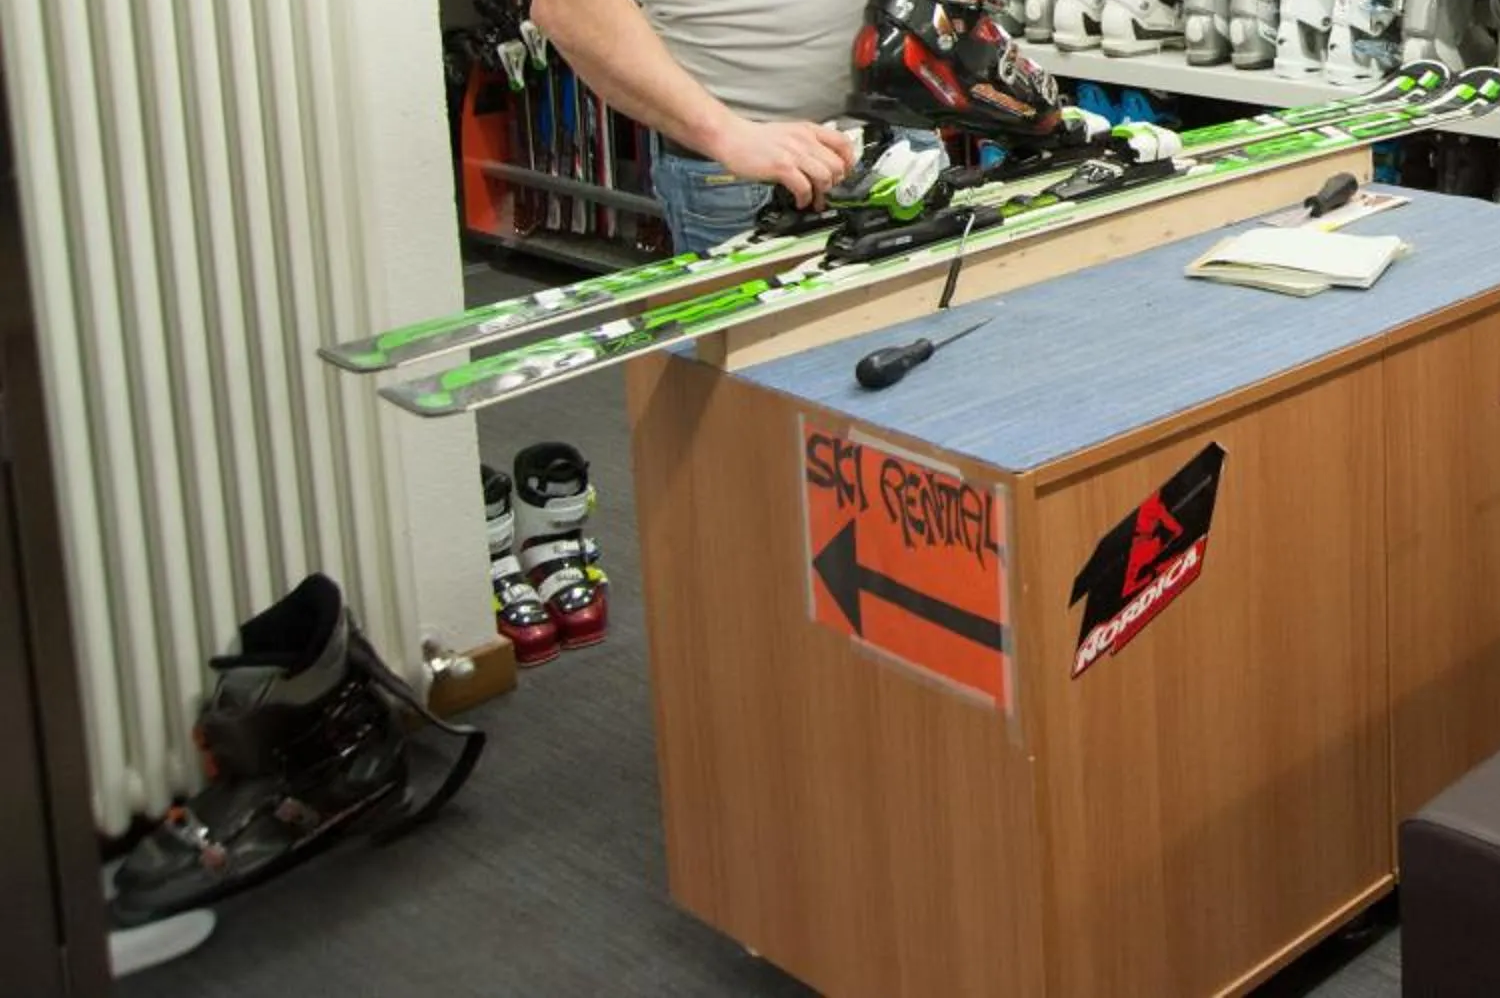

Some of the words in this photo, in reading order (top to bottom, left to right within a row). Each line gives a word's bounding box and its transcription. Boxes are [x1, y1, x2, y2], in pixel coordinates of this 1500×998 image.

[806, 433, 869, 511] SKI
[880, 458, 1001, 570] RENTAL
[1073, 546, 1198, 671] NORDICA
